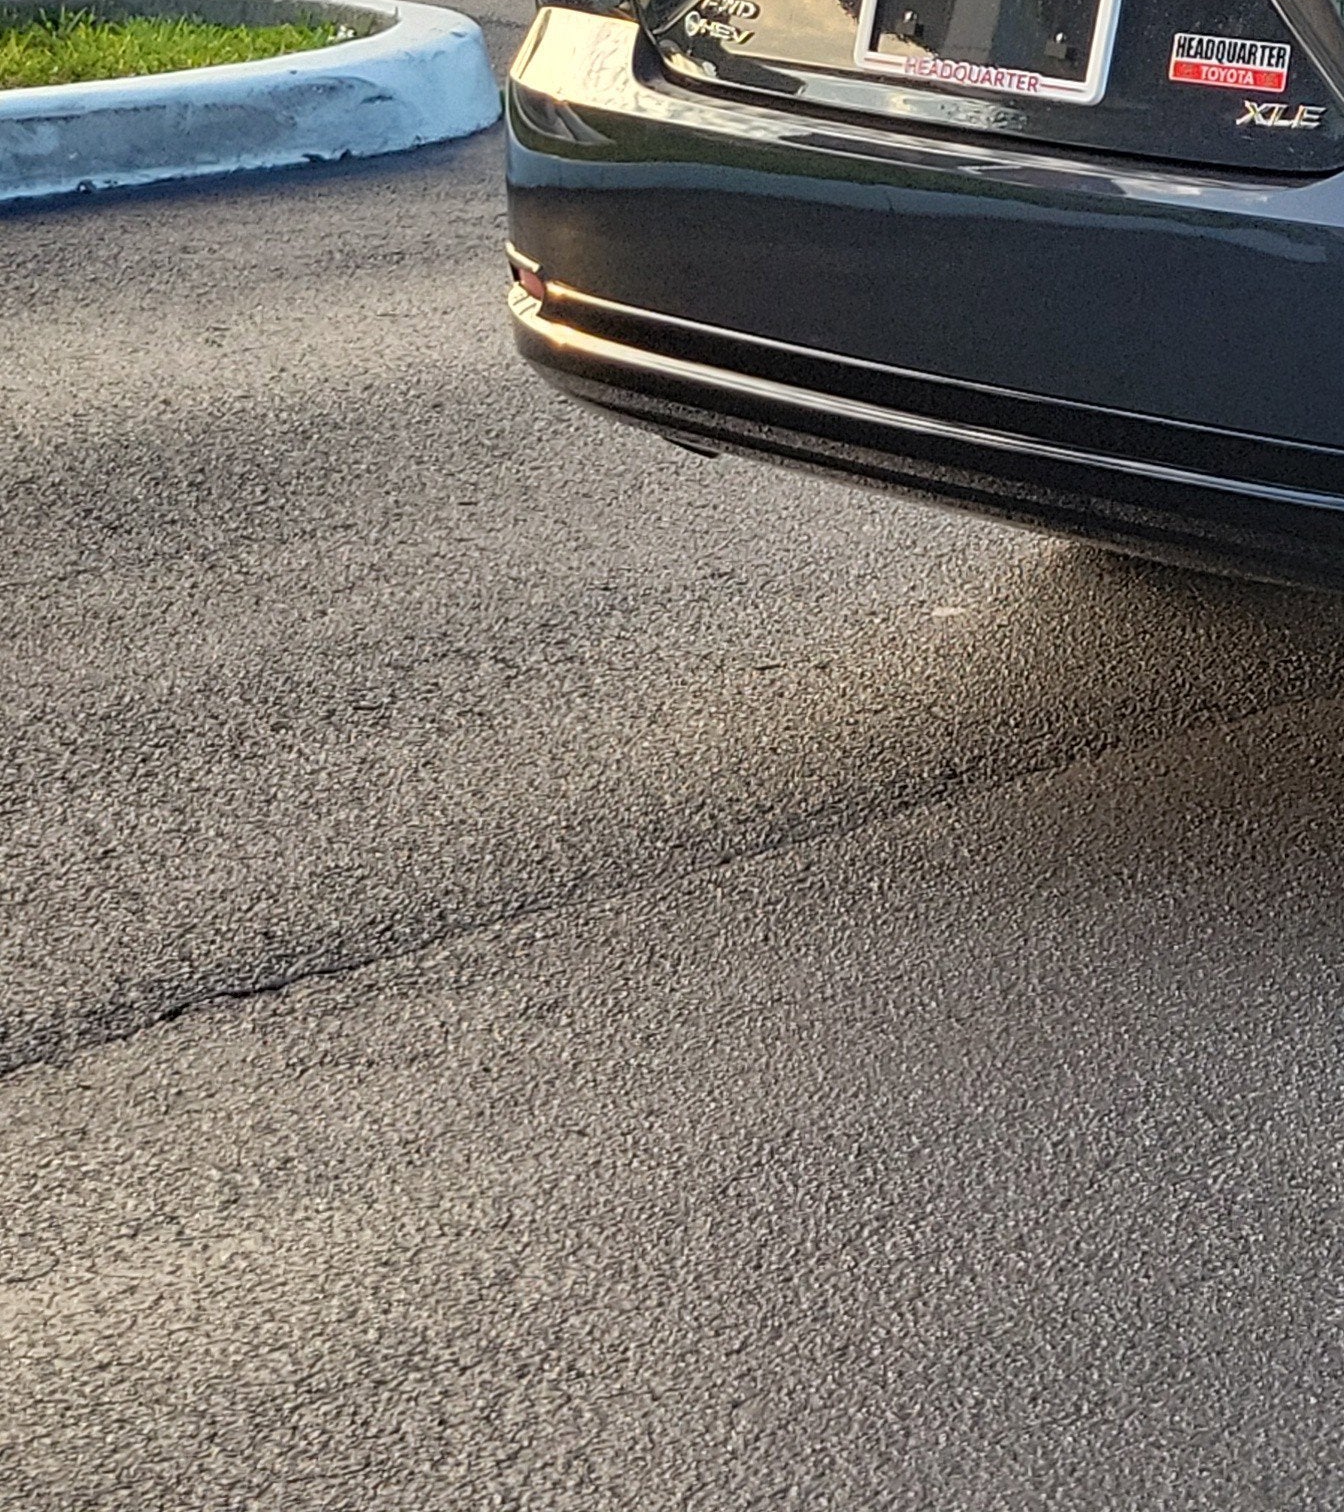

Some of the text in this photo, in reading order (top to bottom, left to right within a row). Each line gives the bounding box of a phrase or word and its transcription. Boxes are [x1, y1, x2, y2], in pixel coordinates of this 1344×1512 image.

[1175, 35, 1287, 69] HEADQUARTER
[904, 56, 1040, 93] HEADQUARTER
[1200, 66, 1254, 85] TOYOTA
[1235, 99, 1327, 130] XLE
